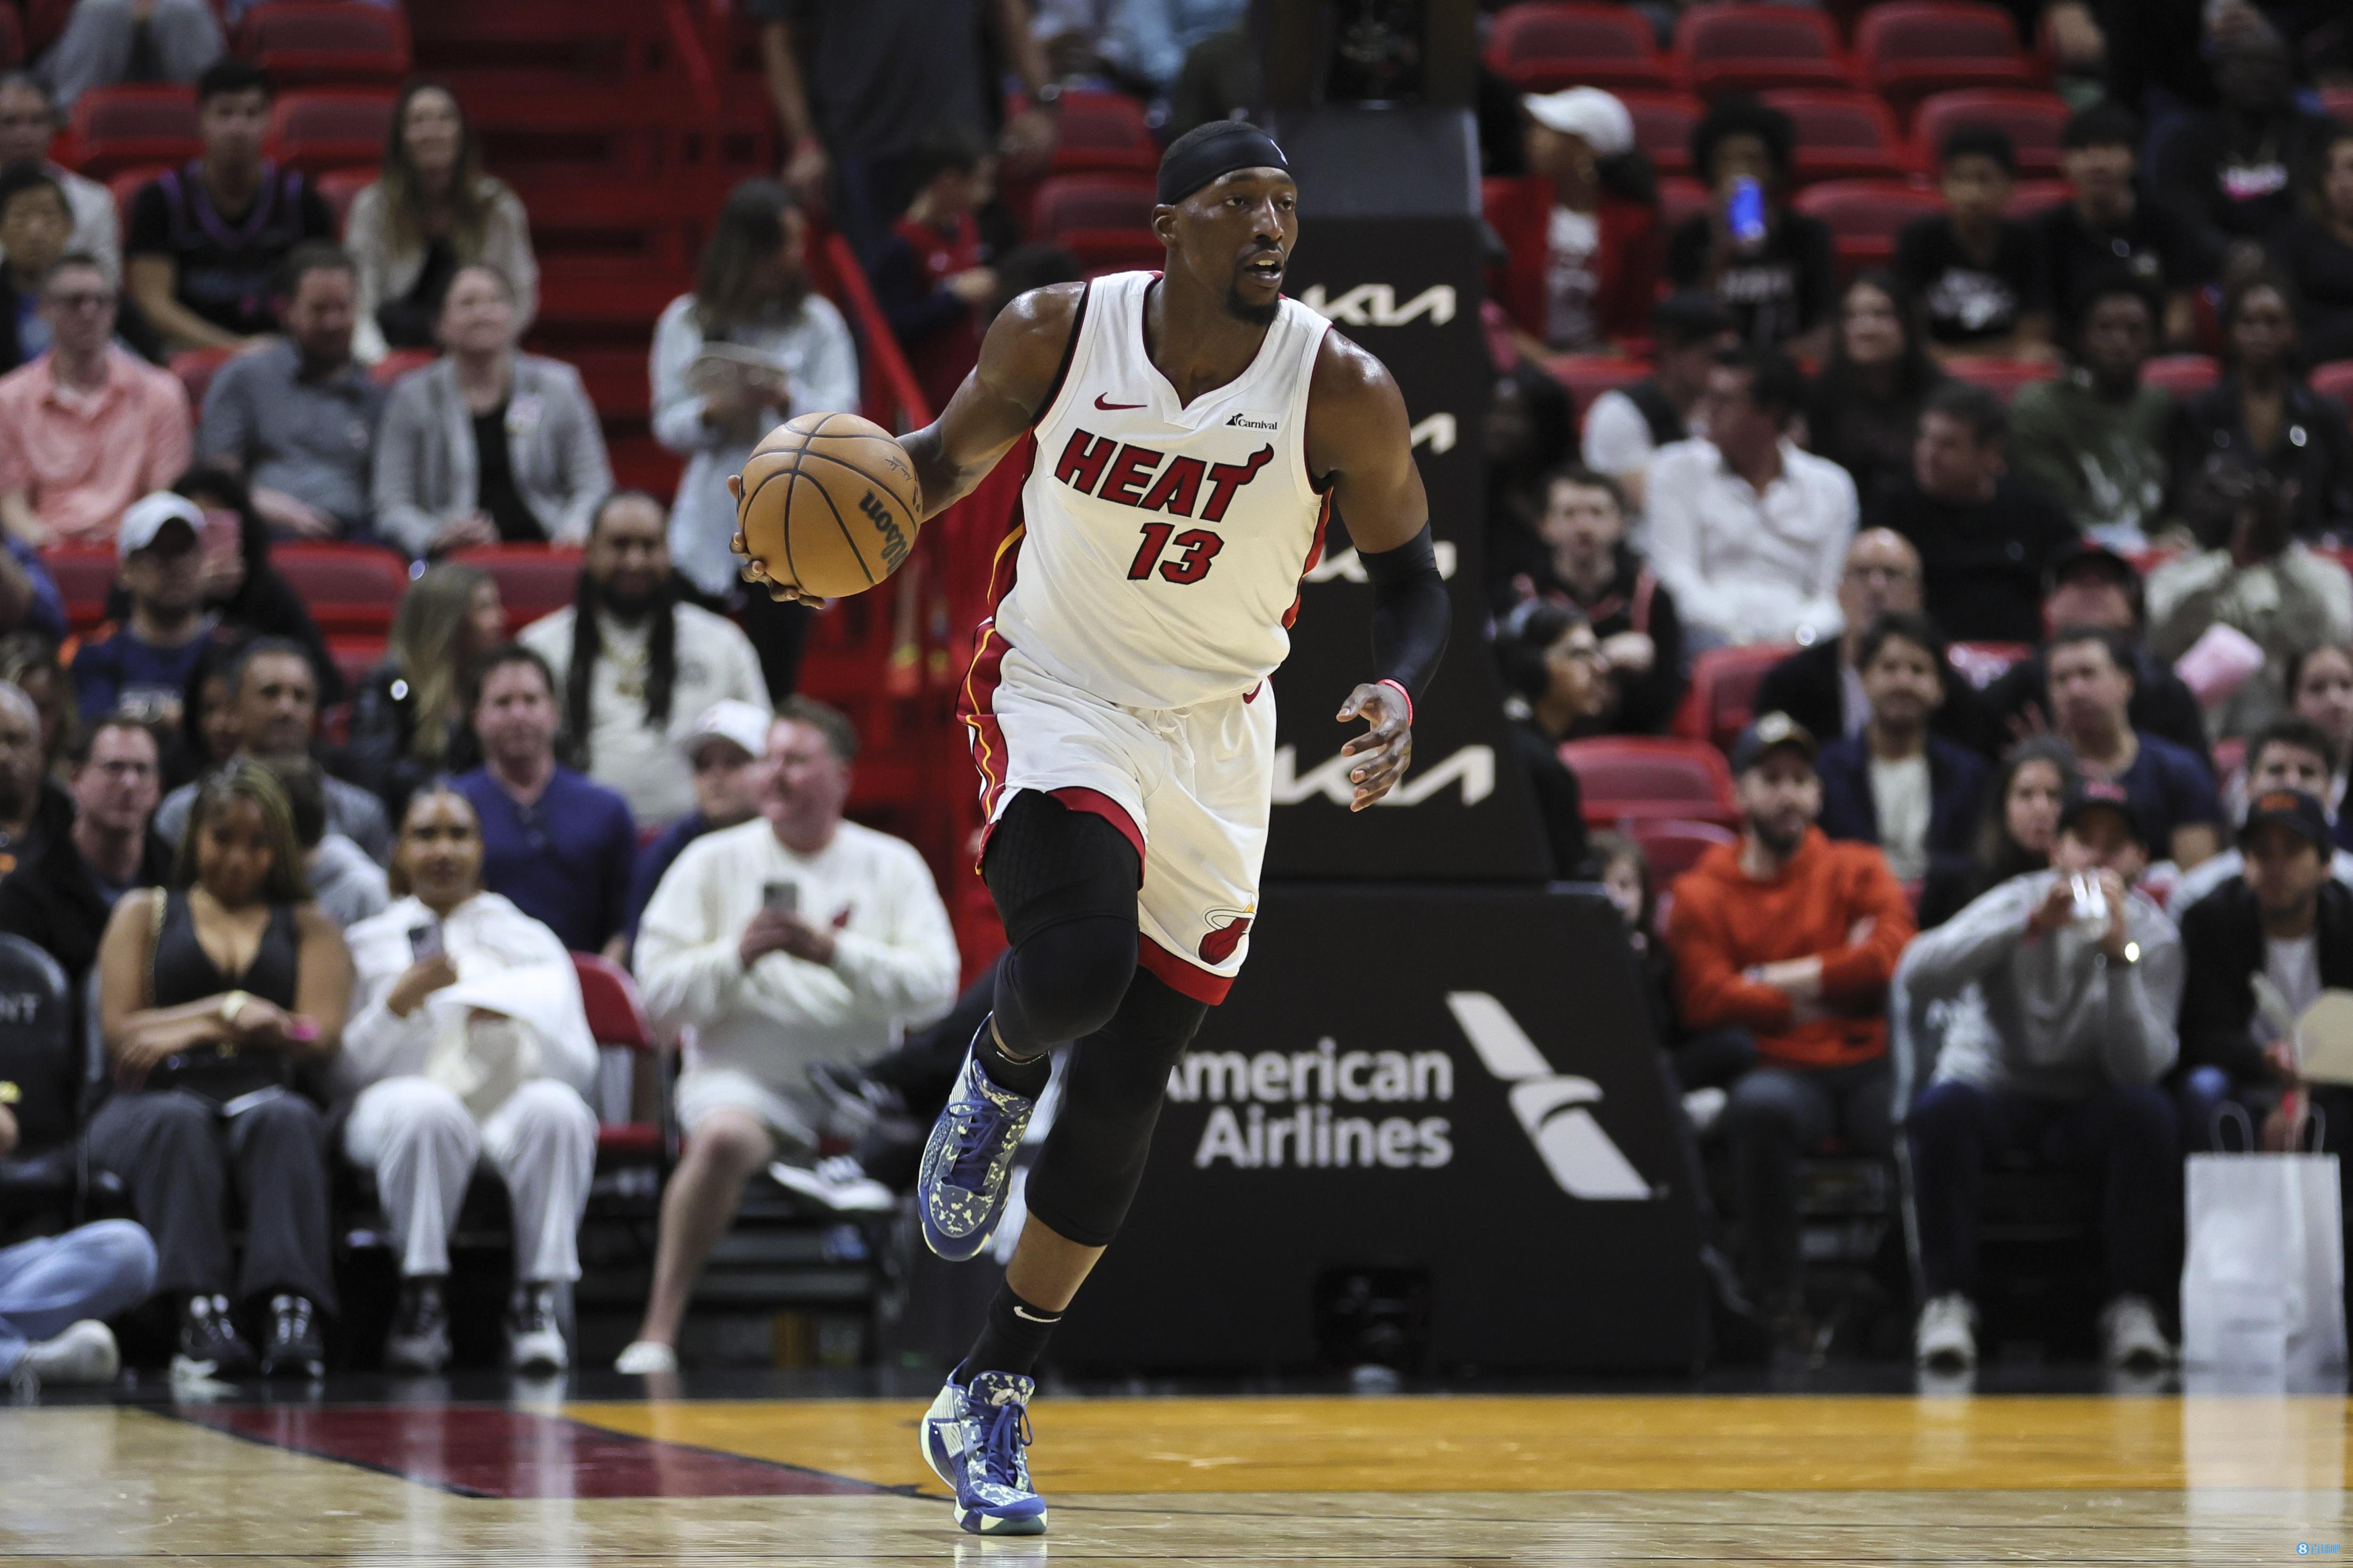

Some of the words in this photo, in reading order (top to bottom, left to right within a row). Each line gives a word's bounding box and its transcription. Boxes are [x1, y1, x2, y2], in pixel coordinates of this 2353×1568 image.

[1238, 419, 1277, 429] Carnival
[1054, 427, 1275, 523] HEAT
[858, 488, 909, 576] ilson
[1127, 522, 1225, 585] 13
[1194, 1104, 1454, 1168] Airlines
